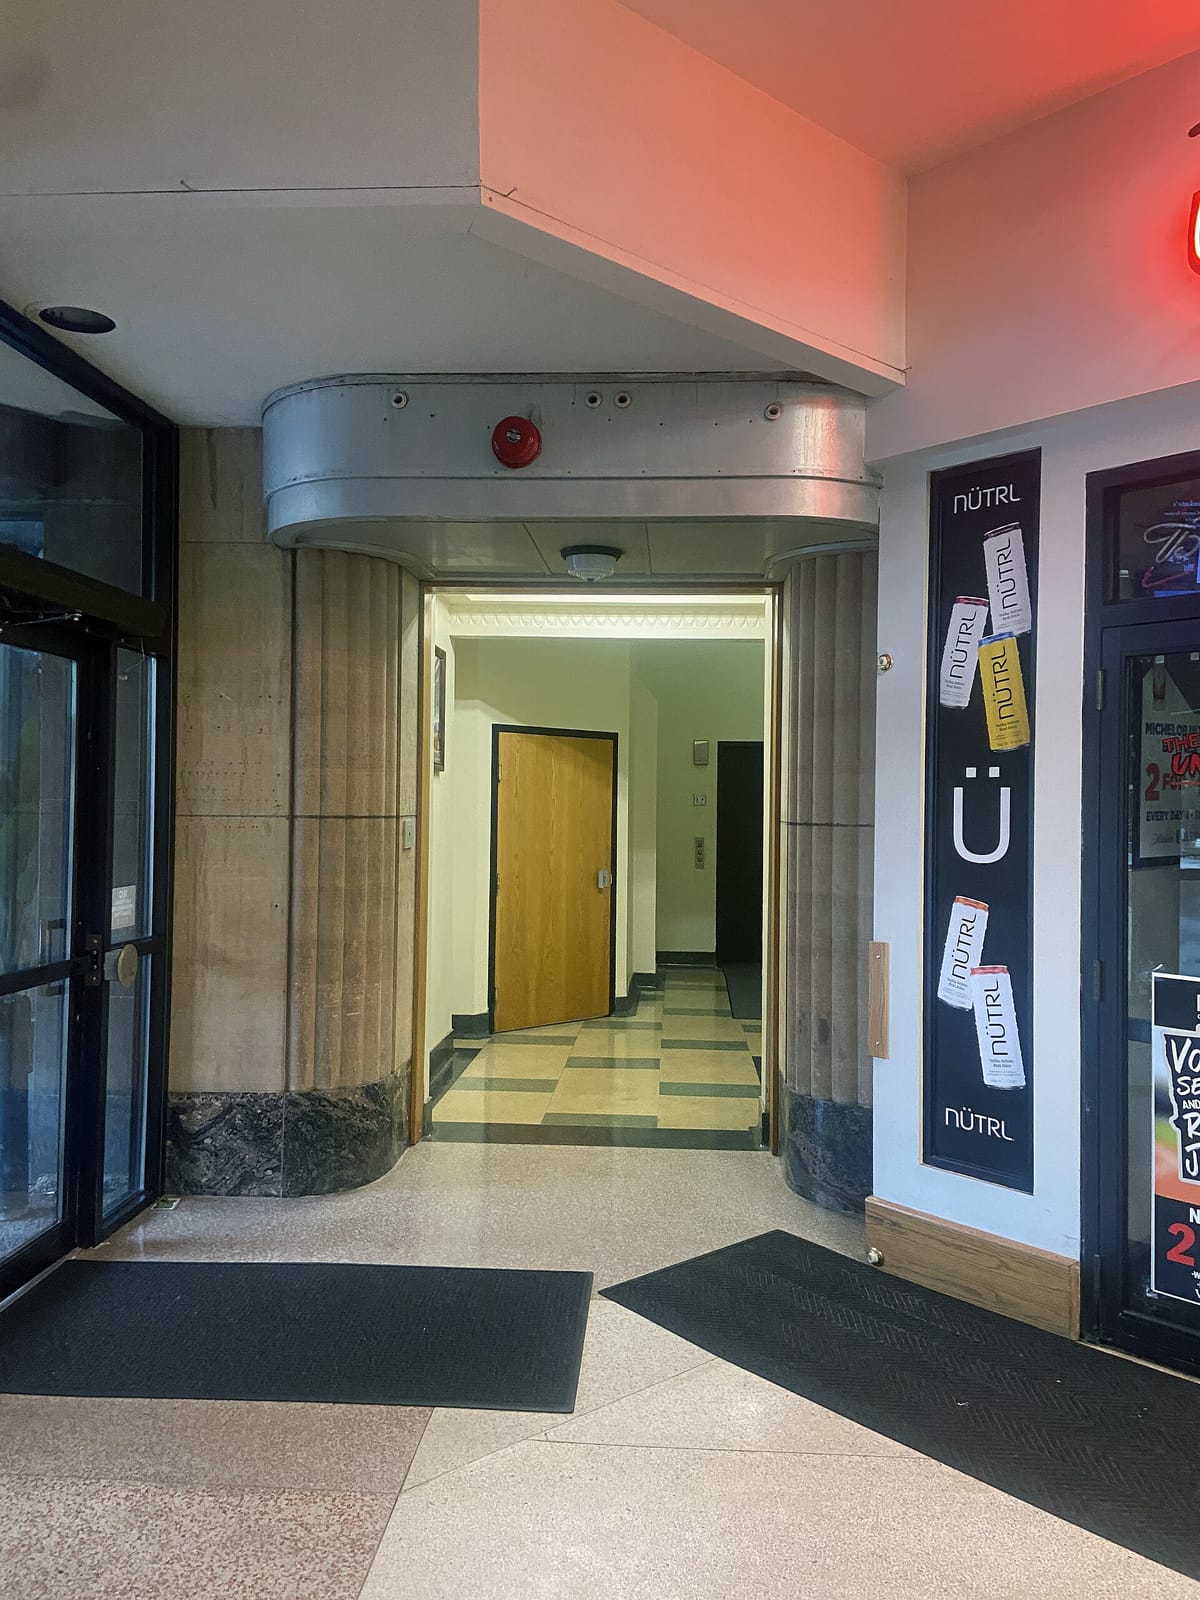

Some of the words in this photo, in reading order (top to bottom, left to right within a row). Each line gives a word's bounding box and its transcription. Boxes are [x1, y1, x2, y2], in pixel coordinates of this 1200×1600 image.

[1145, 762, 1160, 801] 2
[953, 767, 1011, 864] Ü
[1166, 1222, 1195, 1267] 2
